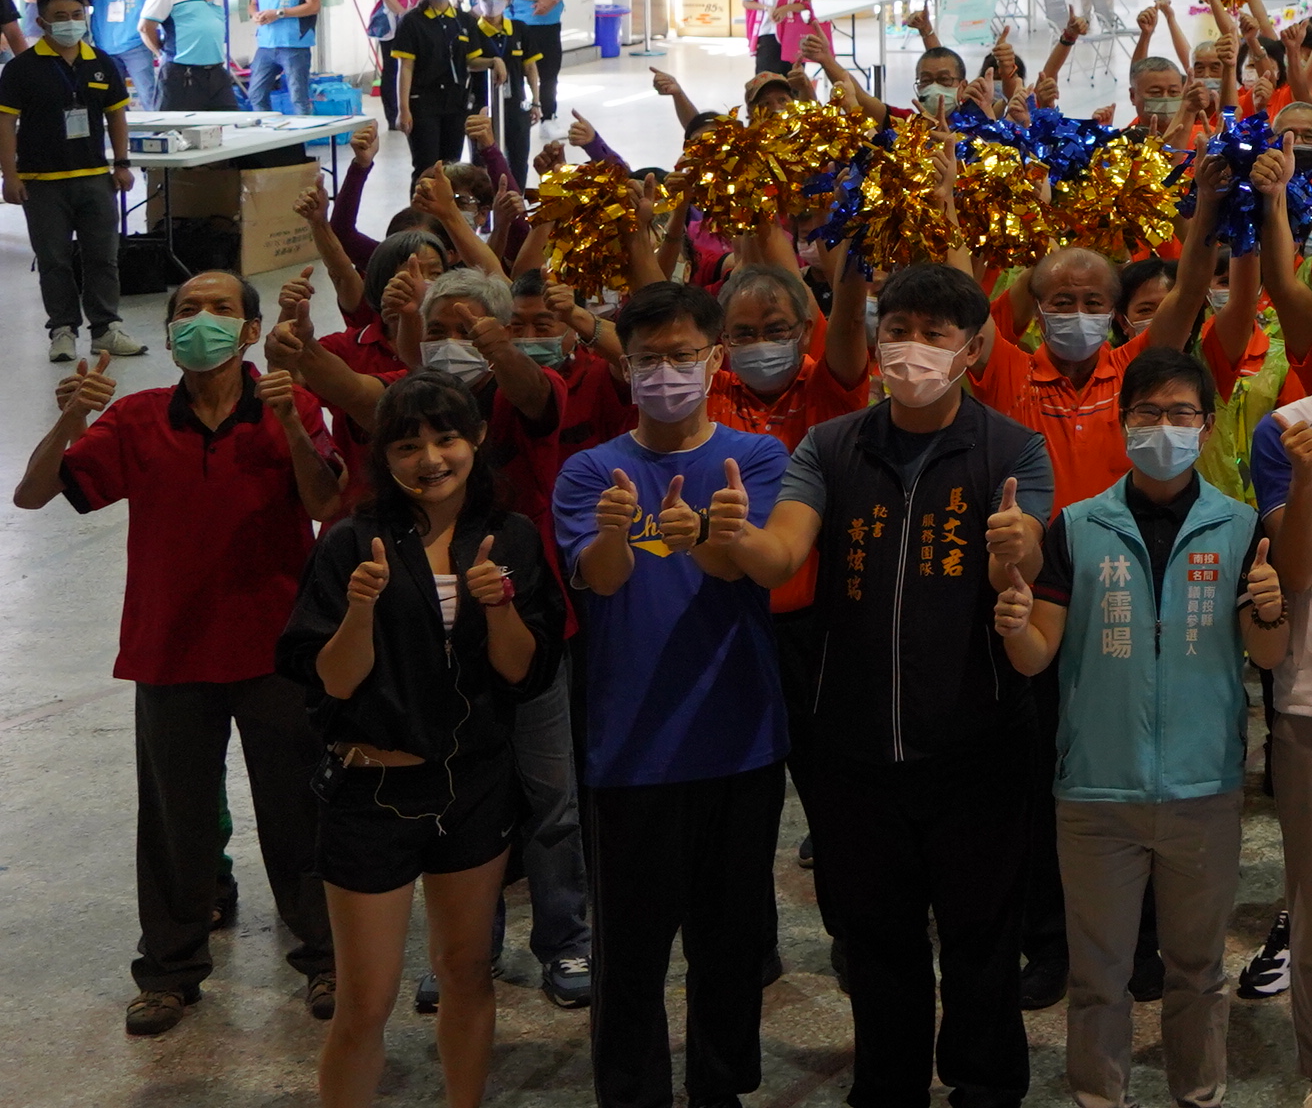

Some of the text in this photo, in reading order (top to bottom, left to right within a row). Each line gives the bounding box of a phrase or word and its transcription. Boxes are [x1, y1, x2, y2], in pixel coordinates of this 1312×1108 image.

[871, 504, 888, 538] 秘書
[920, 513, 936, 577] 服務團隊
[940, 486, 969, 577] 馬文君
[1192, 571, 1214, 581] 名間
[1193, 554, 1215, 564] 南投
[1099, 555, 1132, 659] 林儒暘
[1186, 586, 1201, 656] 議員參選人
[1201, 586, 1216, 626] 南投縣
